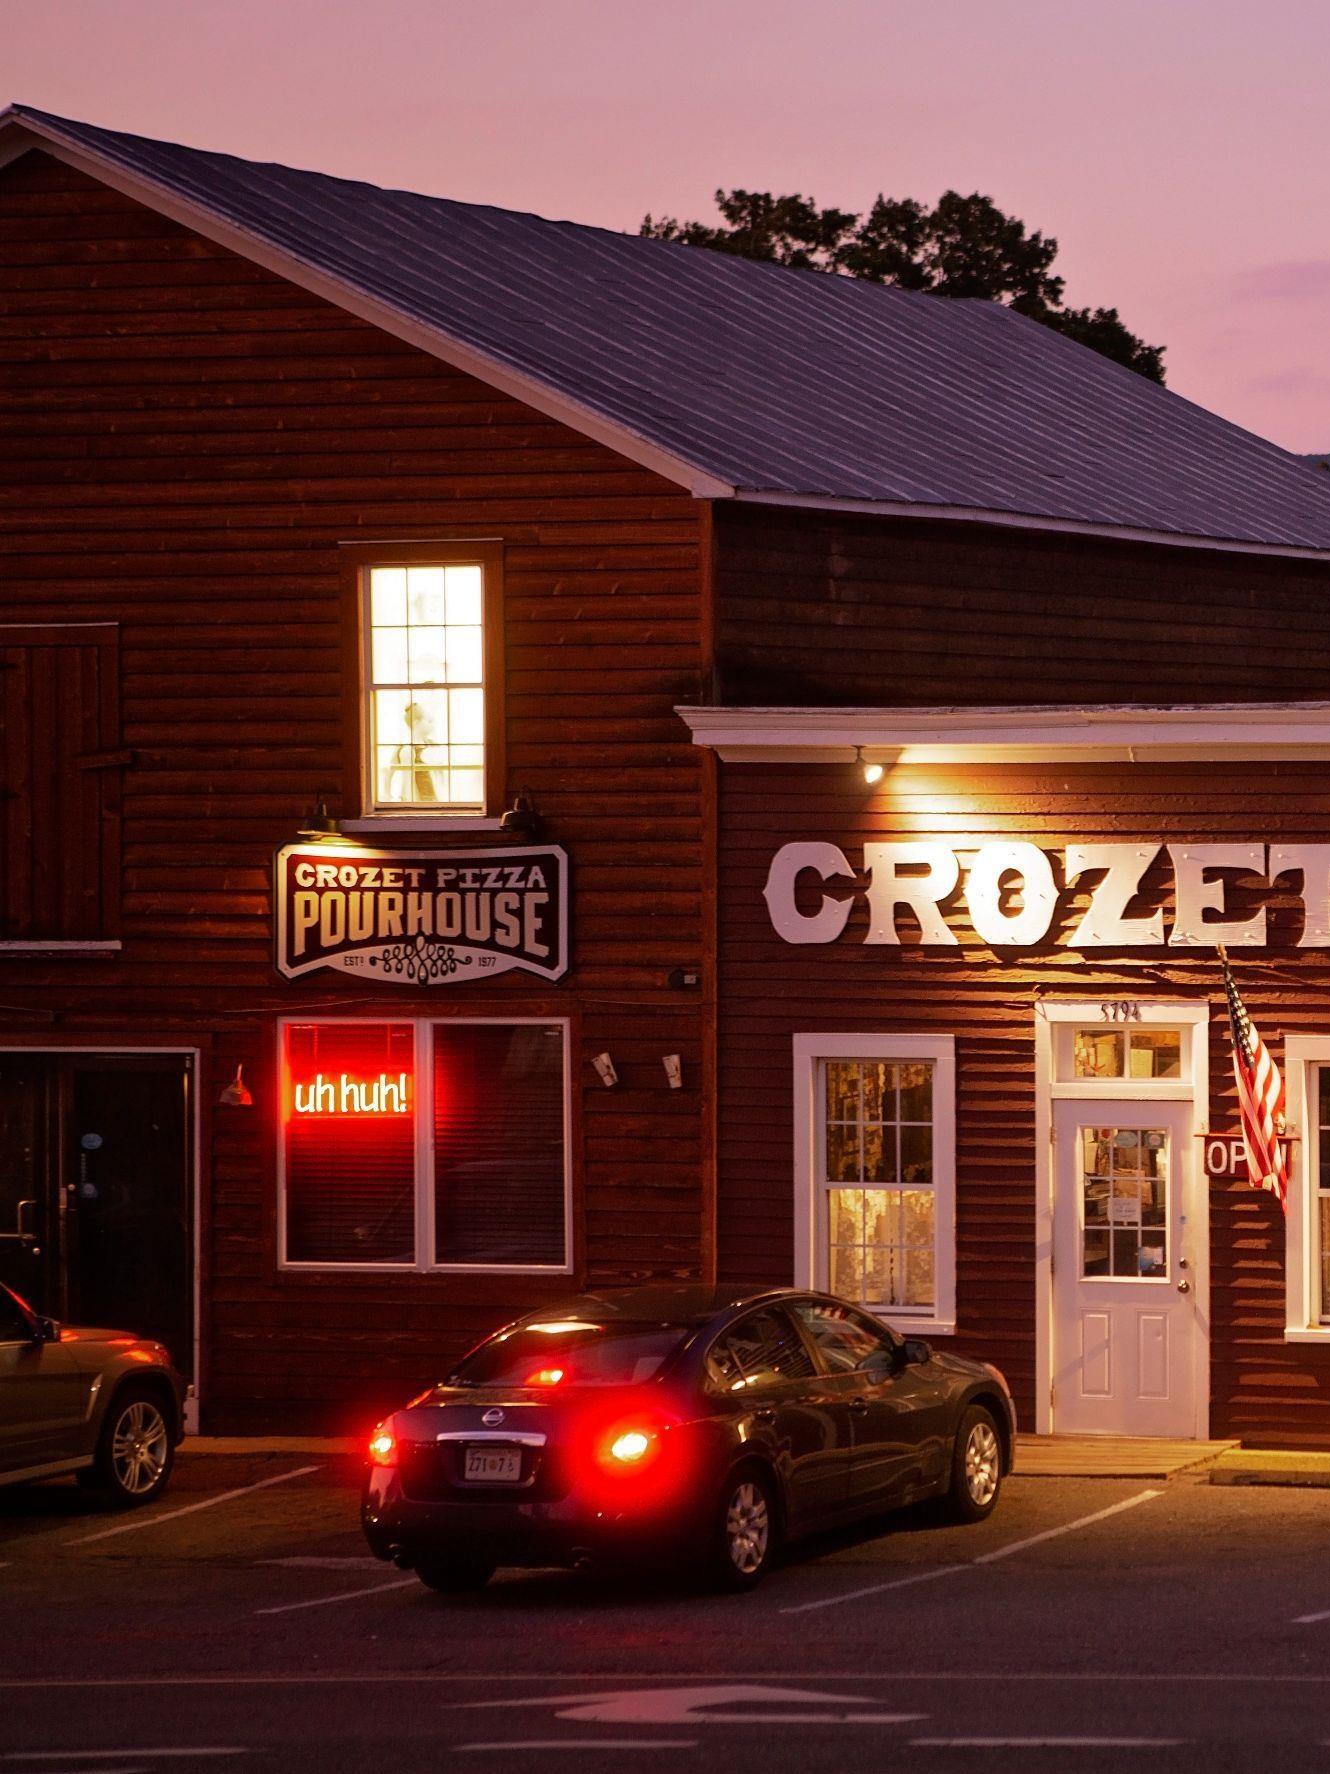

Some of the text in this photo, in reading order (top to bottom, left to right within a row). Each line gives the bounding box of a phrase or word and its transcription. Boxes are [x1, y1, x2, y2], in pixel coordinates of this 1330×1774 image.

[294, 862, 547, 888] CROZET PIZZA
[293, 891, 550, 958] POURHOUSE
[1100, 1001, 1140, 1021] 5794
[295, 1073, 407, 1112] uh huh!
